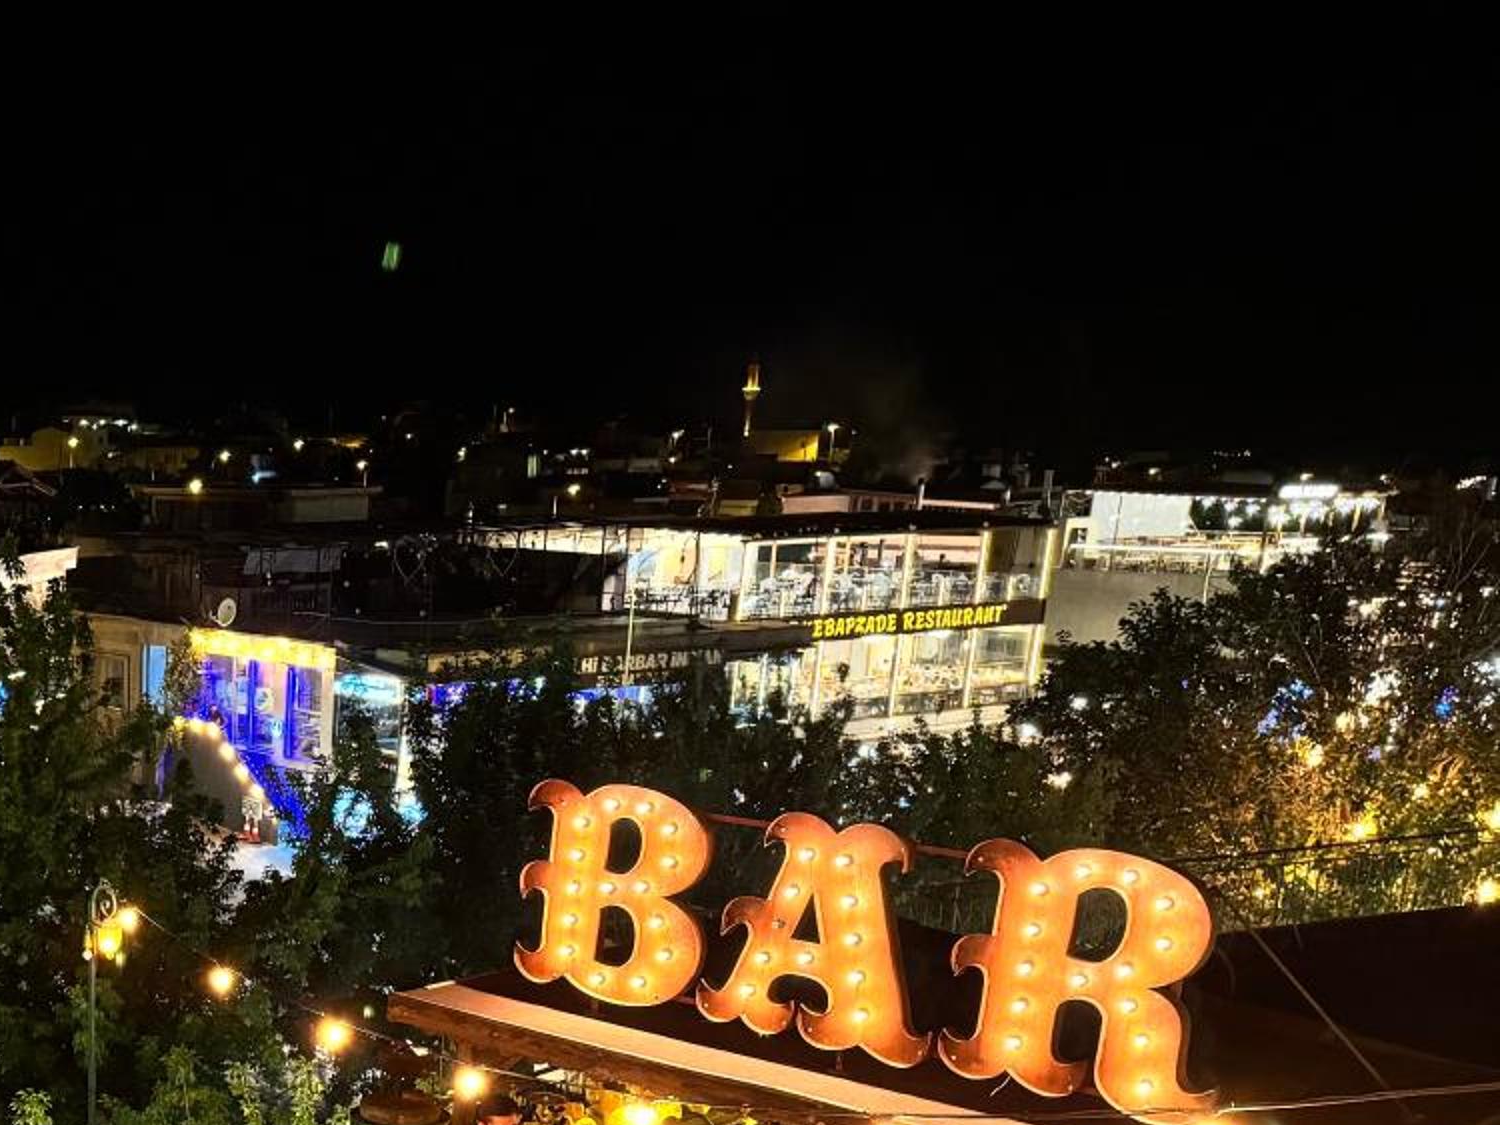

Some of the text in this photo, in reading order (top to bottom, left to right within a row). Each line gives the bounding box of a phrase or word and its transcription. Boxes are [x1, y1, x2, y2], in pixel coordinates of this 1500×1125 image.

[804, 604, 1008, 637] EBAPZADE RESTAURANT
[514, 779, 1217, 1125] BAR
